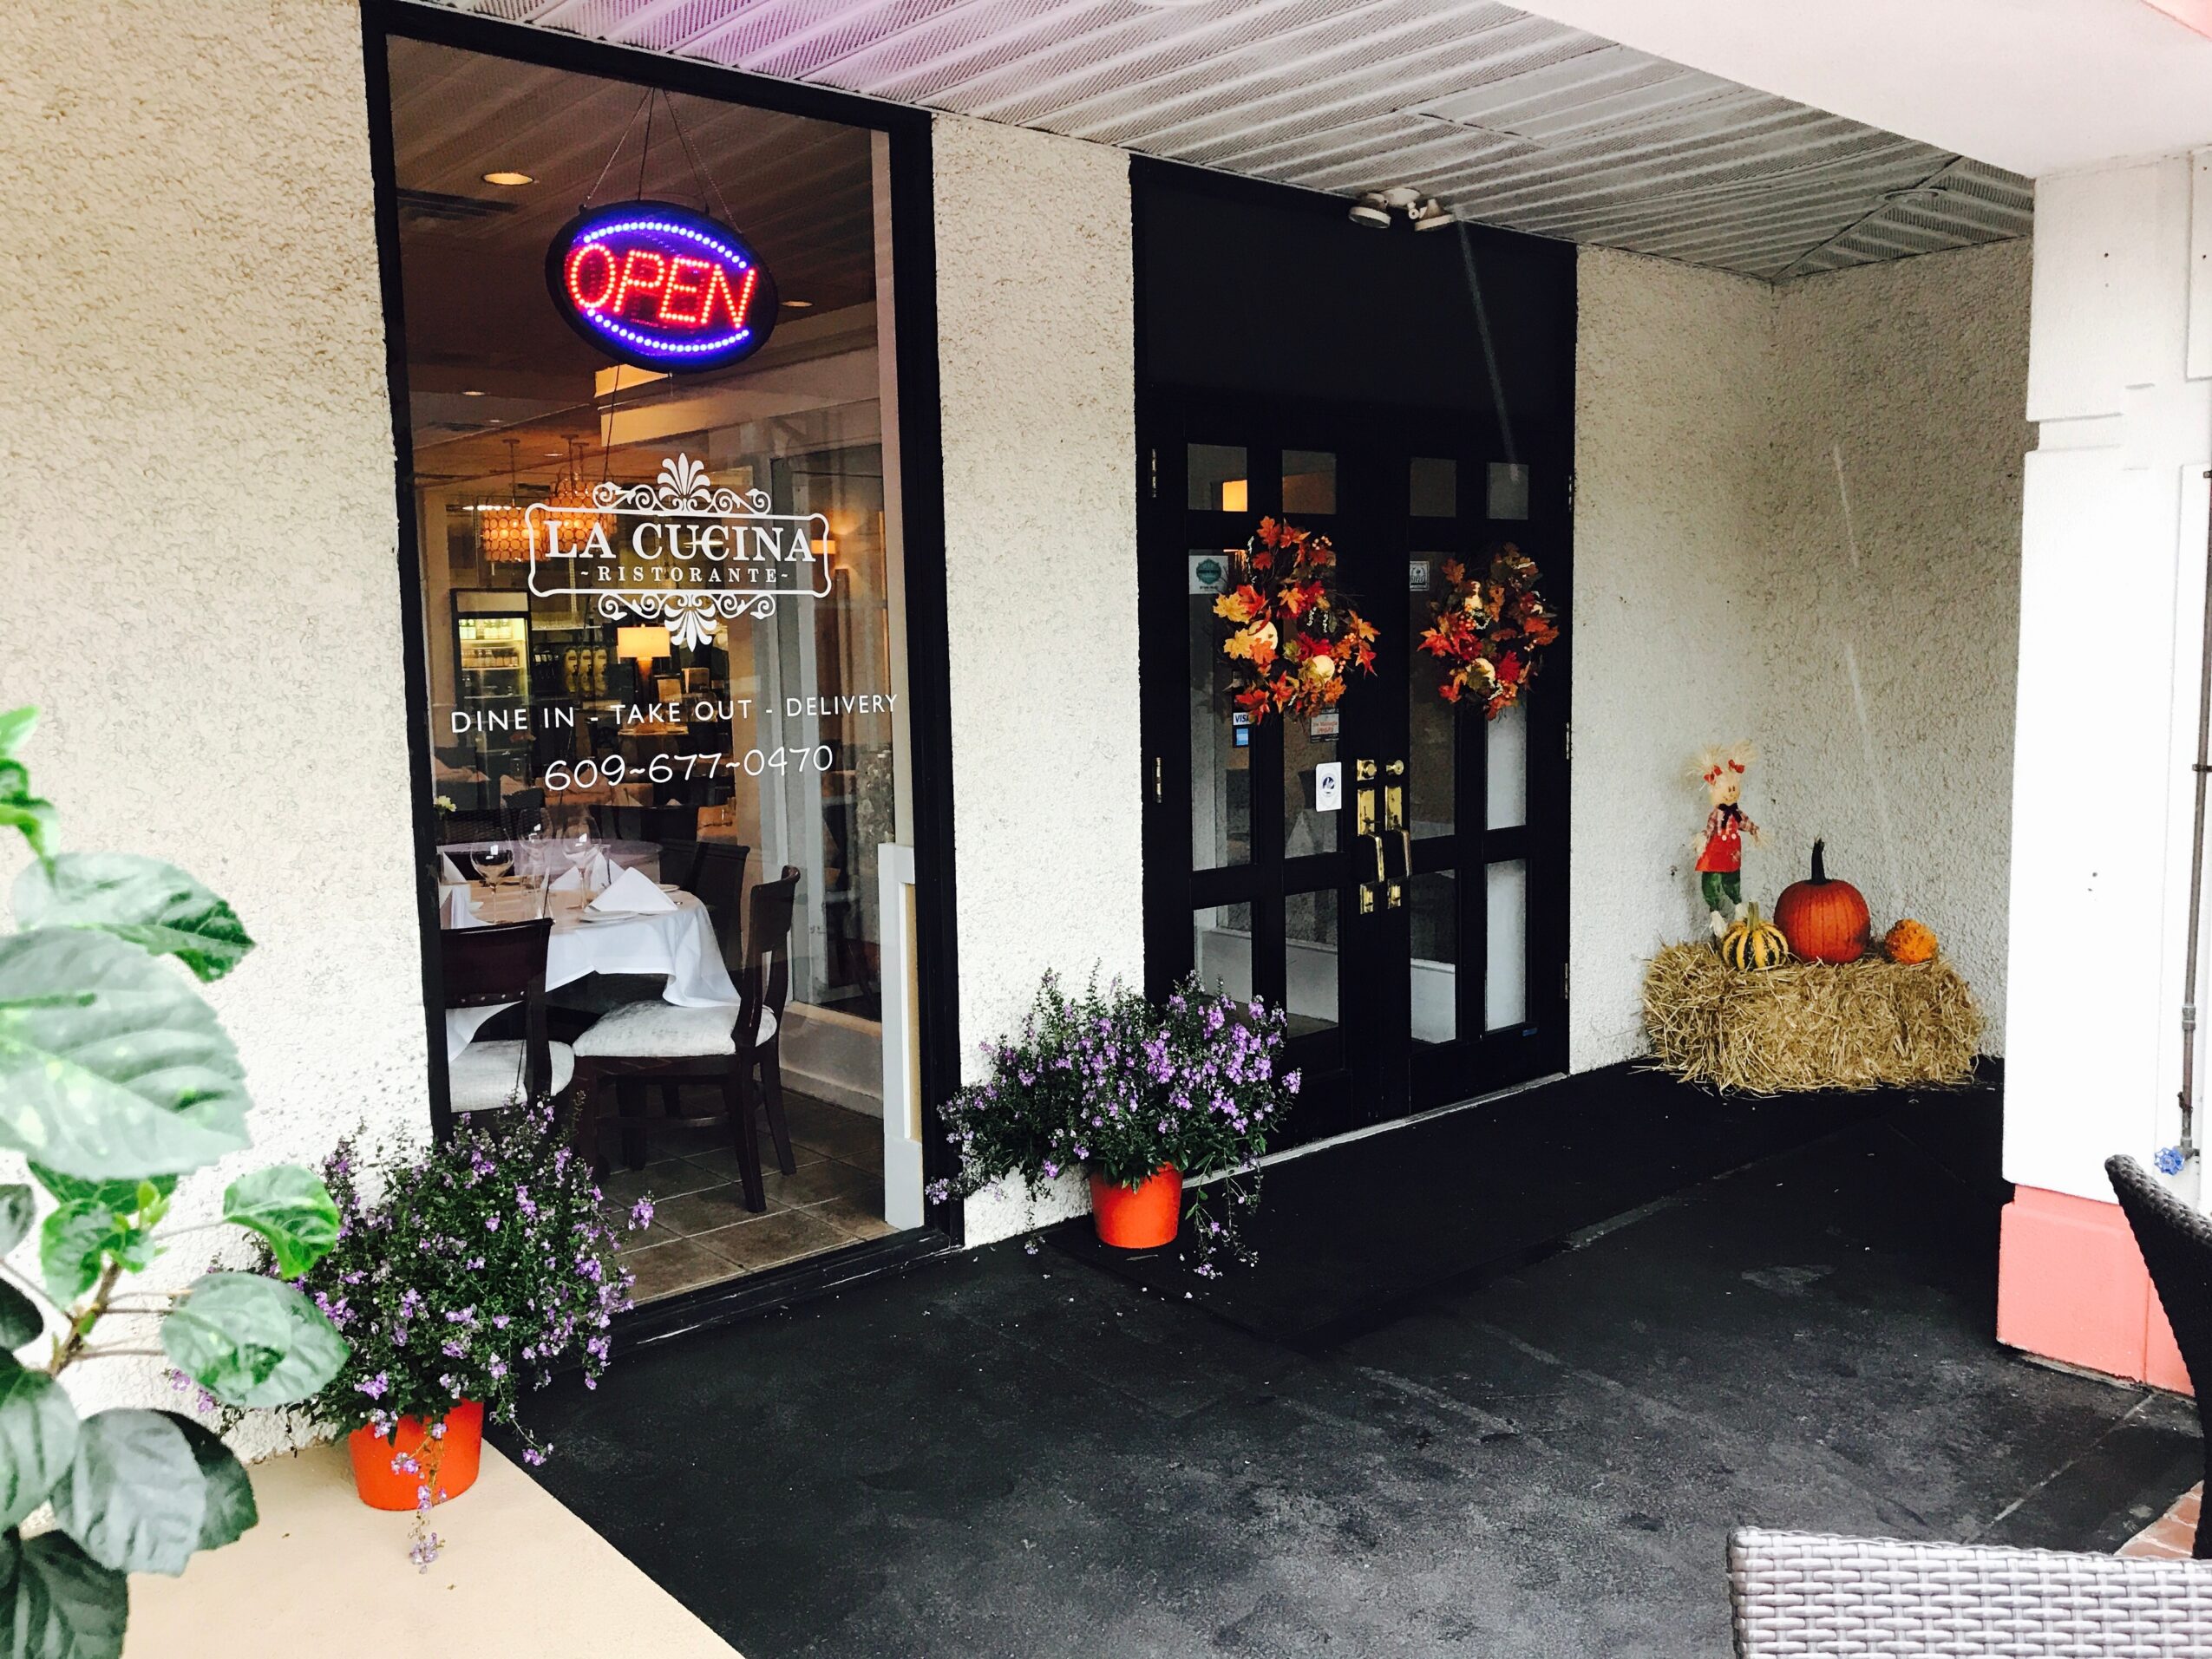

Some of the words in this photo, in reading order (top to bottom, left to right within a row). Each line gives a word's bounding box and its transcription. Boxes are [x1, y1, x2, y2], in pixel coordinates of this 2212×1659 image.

[569, 242, 756, 330] OPEN
[545, 519, 617, 559] LA
[632, 522, 816, 562] CUCINA
[450, 708, 528, 734] DINE
[544, 706, 575, 728] IN
[609, 702, 682, 726] TAKE
[695, 699, 752, 722] OUT
[786, 694, 898, 717] DELIVERY
